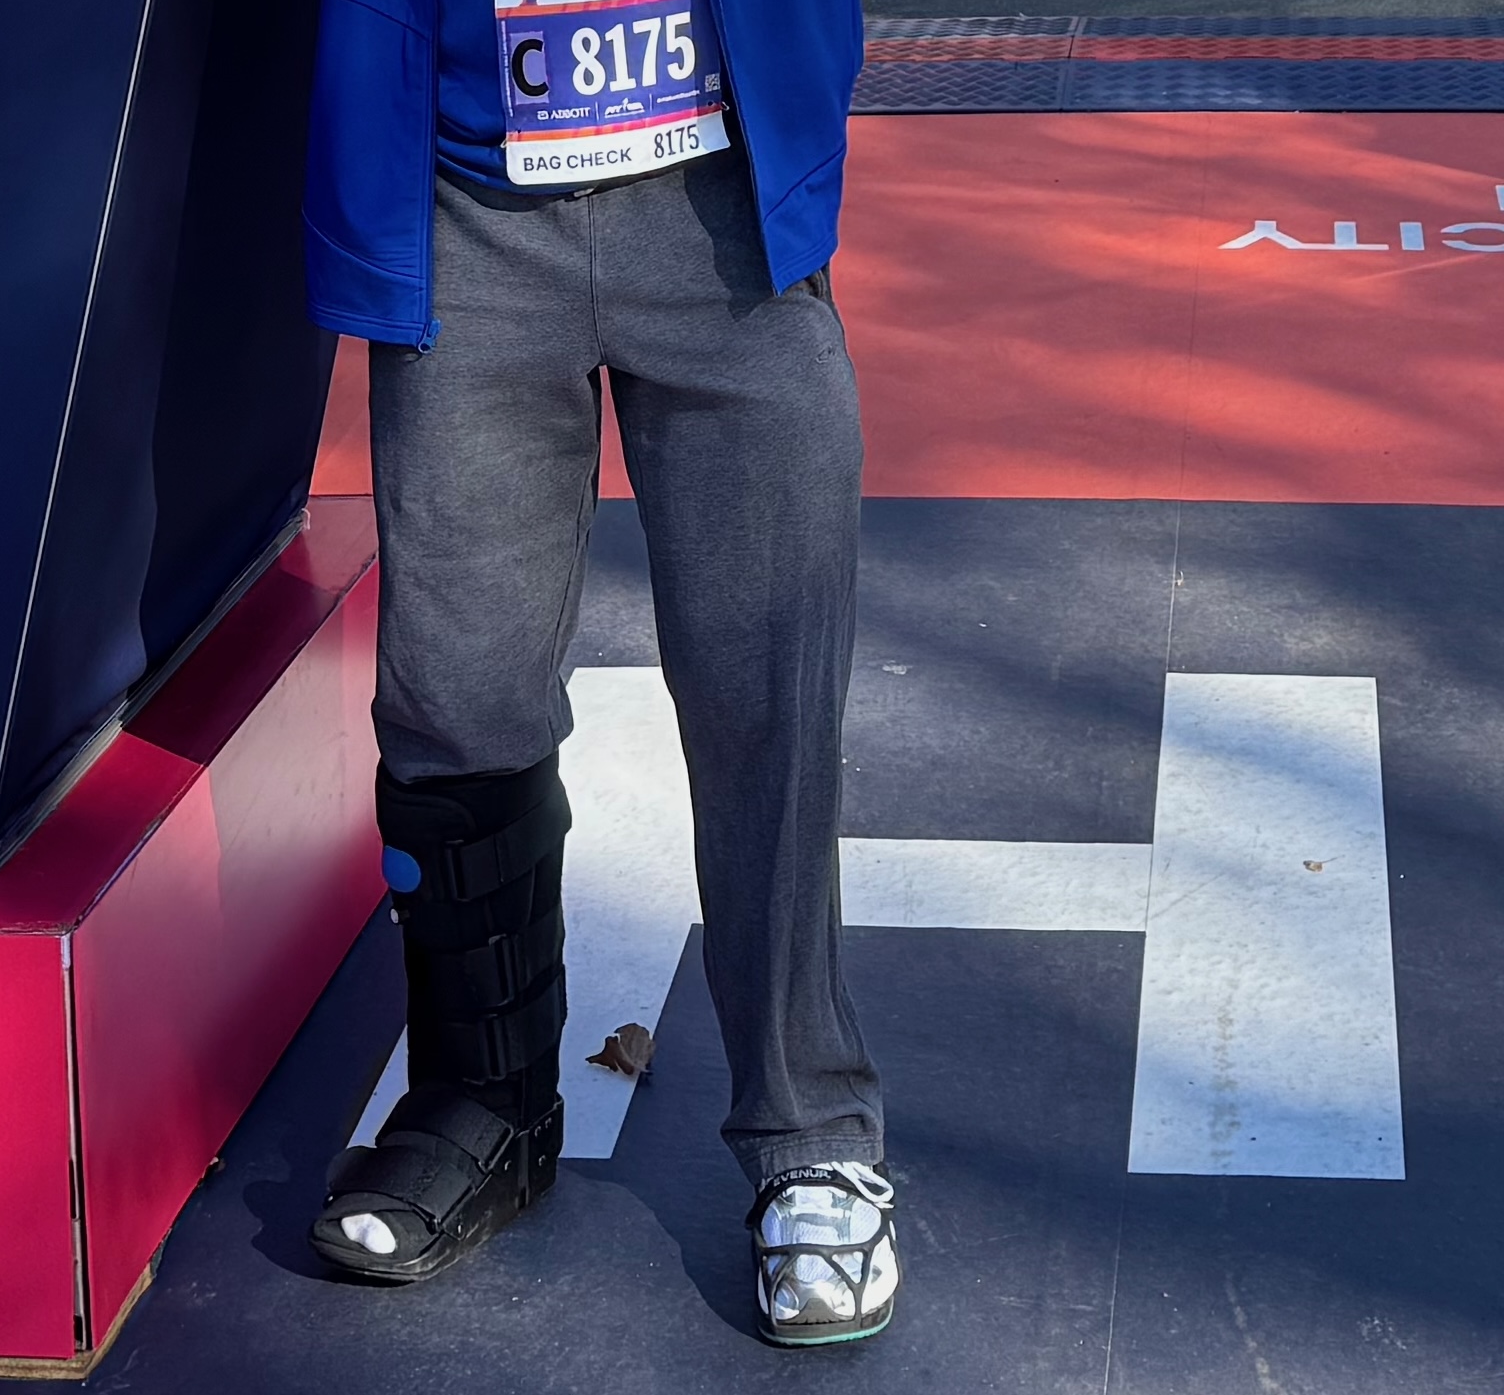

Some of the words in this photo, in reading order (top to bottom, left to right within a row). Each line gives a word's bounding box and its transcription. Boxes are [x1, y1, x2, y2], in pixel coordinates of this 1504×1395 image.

[511, 38, 550, 98] C
[571, 11, 697, 97] 8175
[523, 154, 562, 173] BAG
[566, 147, 633, 170] CHECK
[654, 123, 700, 160] 8175
[1217, 220, 1504, 252] CITY
